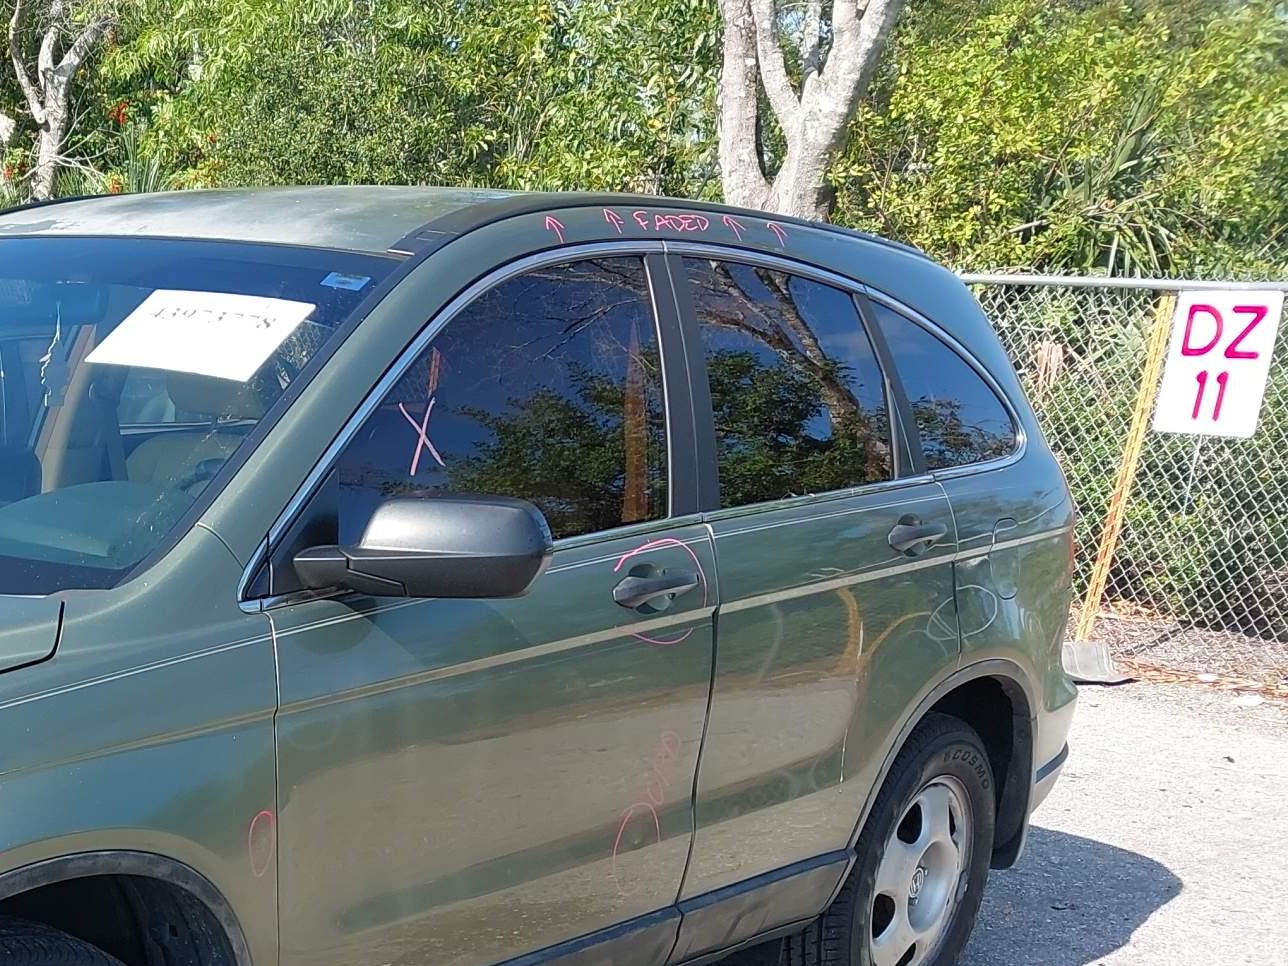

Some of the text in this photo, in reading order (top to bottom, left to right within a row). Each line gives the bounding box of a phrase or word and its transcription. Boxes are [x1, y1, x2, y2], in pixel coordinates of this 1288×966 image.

[632, 209, 711, 232] FADED
[1181, 304, 1268, 359] DZ
[1196, 370, 1229, 421] 11
